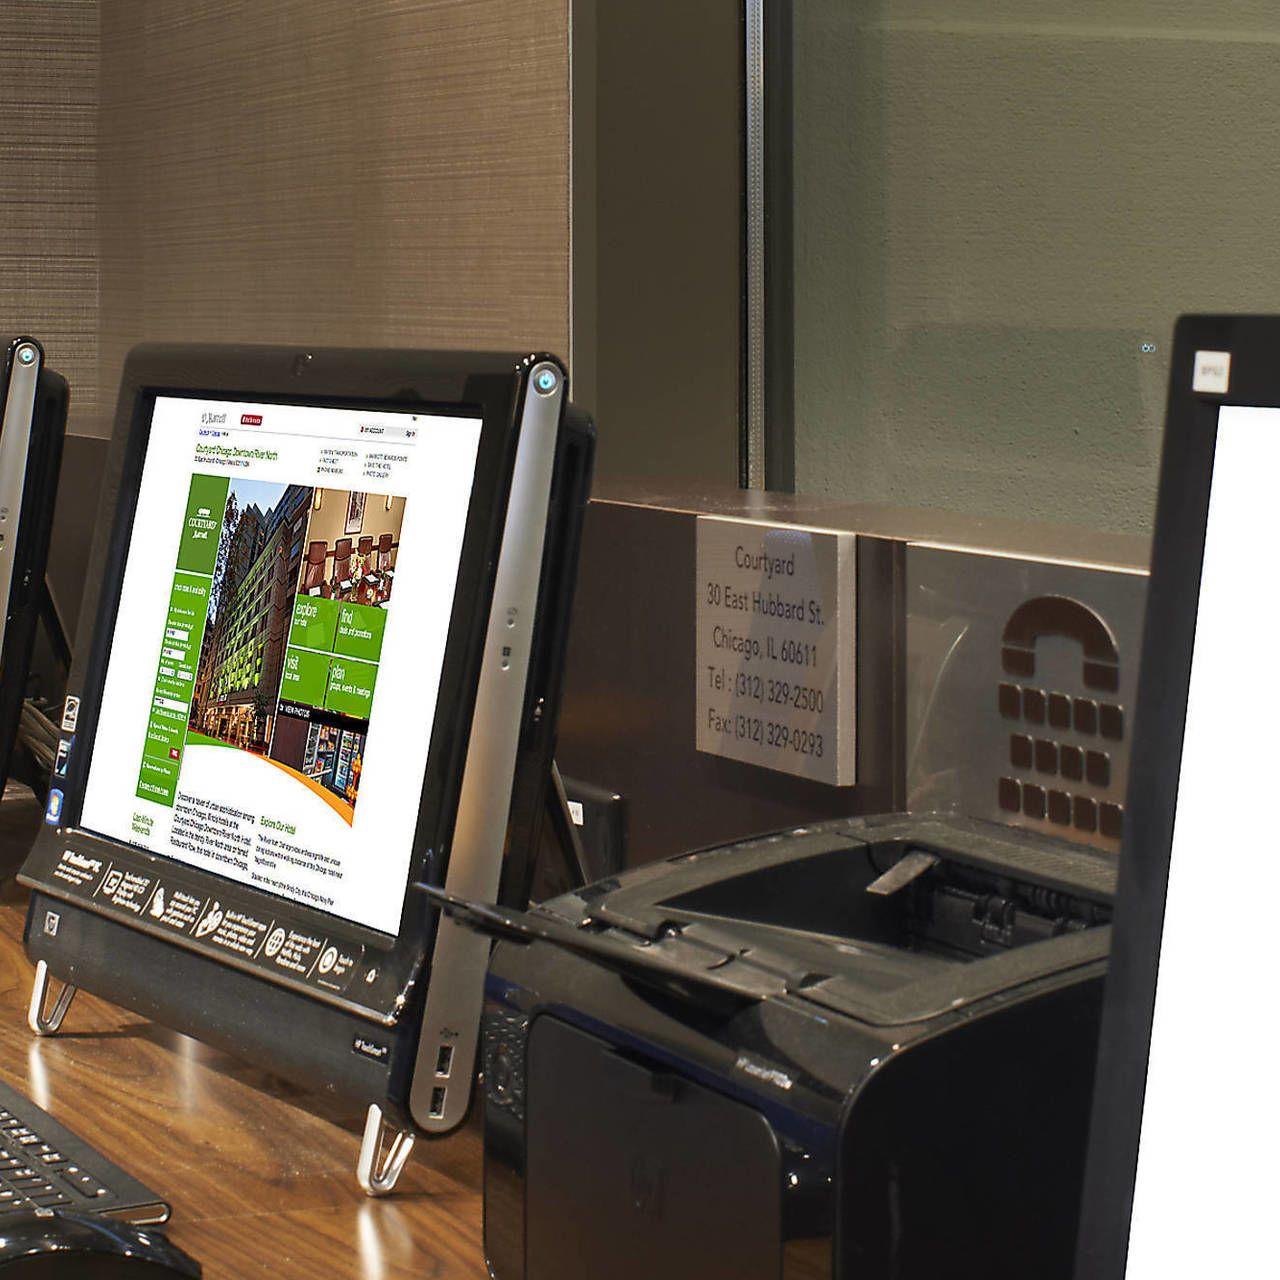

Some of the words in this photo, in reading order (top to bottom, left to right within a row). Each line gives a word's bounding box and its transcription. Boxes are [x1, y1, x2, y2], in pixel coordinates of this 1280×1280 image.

[735, 546, 794, 579] Courtyard
[707, 583, 720, 605] 30
[724, 586, 747, 611] East
[753, 592, 803, 620] Hubbard
[808, 602, 823, 624] St.
[713, 627, 761, 660] Chicago,
[767, 637, 777, 659] IL
[781, 641, 815, 666] 60611
[707, 666, 724, 689] Tel
[735, 673, 763, 701] (312)
[768, 680, 822, 712] 329-2500
[707, 707, 732, 733] Fax:
[735, 715, 762, 743] (312)
[767, 722, 822, 757] 329-0293
